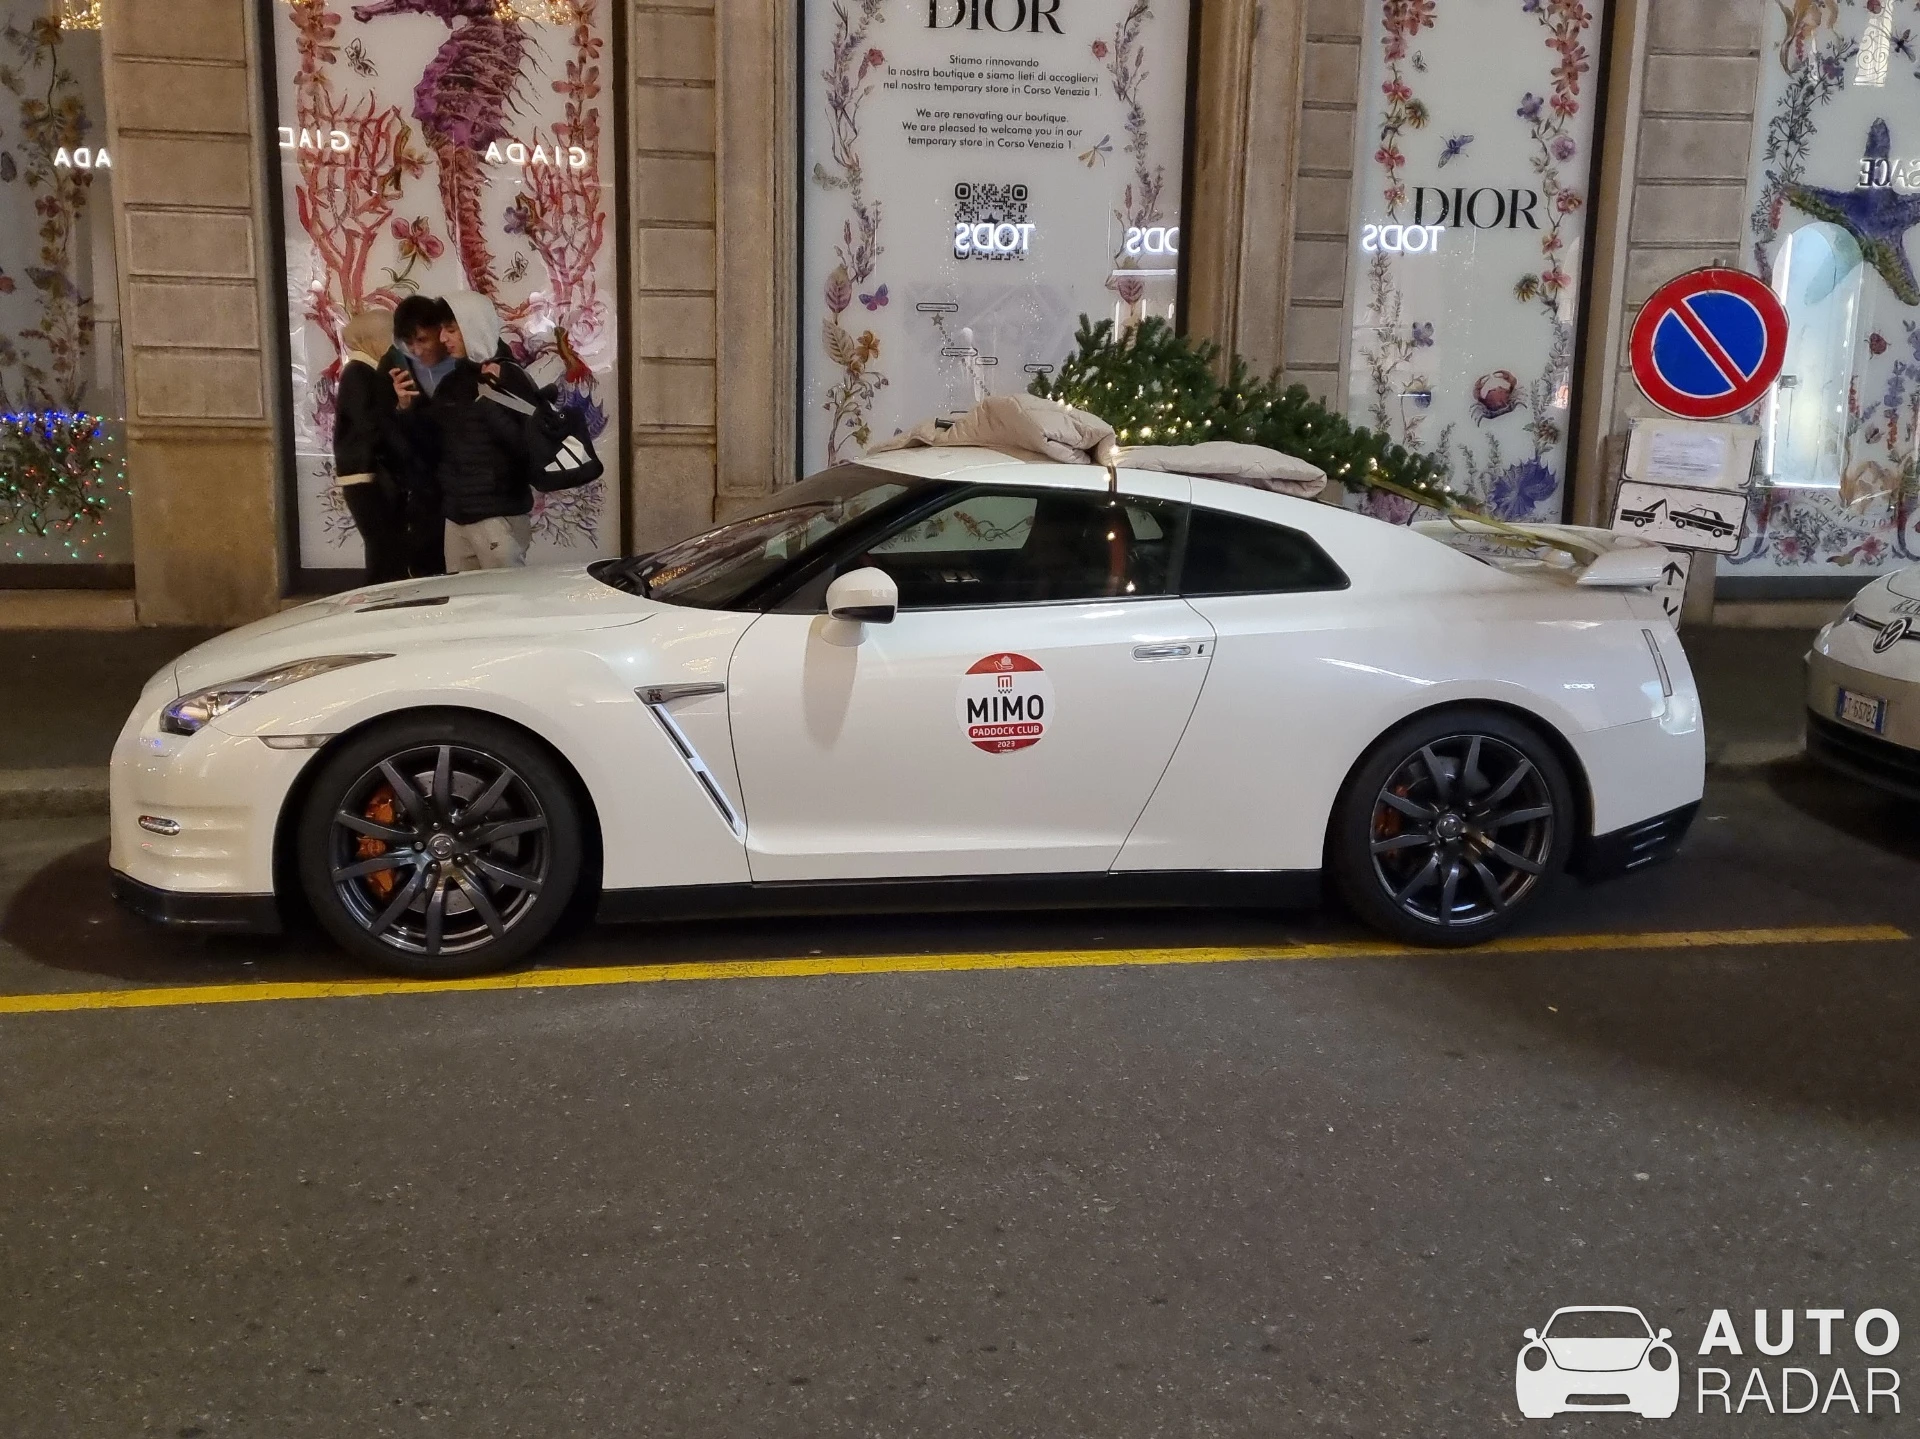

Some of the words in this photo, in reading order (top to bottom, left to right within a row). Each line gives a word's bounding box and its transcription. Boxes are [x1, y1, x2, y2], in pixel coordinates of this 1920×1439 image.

[924, 0, 1067, 34] DIOR
[950, 55, 982, 64] Stiamo
[986, 56, 1039, 67] rinnovando
[888, 65, 896, 75] la
[900, 68, 929, 76] nostra
[933, 67, 974, 80] boutique
[987, 69, 1014, 80] siamo
[1018, 71, 1034, 80] lieti
[1038, 71, 1046, 81] di
[1049, 72, 1098, 84] accogliervi
[884, 80, 898, 89] nel
[902, 82, 930, 90] nostro
[934, 83, 982, 94] temporary
[986, 85, 1008, 93] store
[1012, 85, 1020, 94] in
[1024, 85, 1051, 95] Corso
[1054, 86, 1090, 96] Venezia
[916, 108, 931, 118] We
[953, 111, 1003, 122] renovating
[1025, 112, 1068, 124] boutique.
[902, 121, 917, 131] We
[939, 122, 975, 133] pleased
[979, 125, 987, 133] to
[991, 124, 1032, 135] welcome
[1035, 129, 1051, 137] you
[1056, 127, 1063, 136] in
[908, 136, 956, 148] temporary
[960, 138, 982, 146] store
[986, 138, 994, 147] in
[998, 138, 1024, 148] Corso
[1028, 139, 1064, 149] Venezia
[1412, 187, 1541, 229] DIOR
[967, 695, 1044, 723] MIMO
[972, 726, 1015, 737] PADDOCK
[1017, 725, 1040, 735] CLUB
